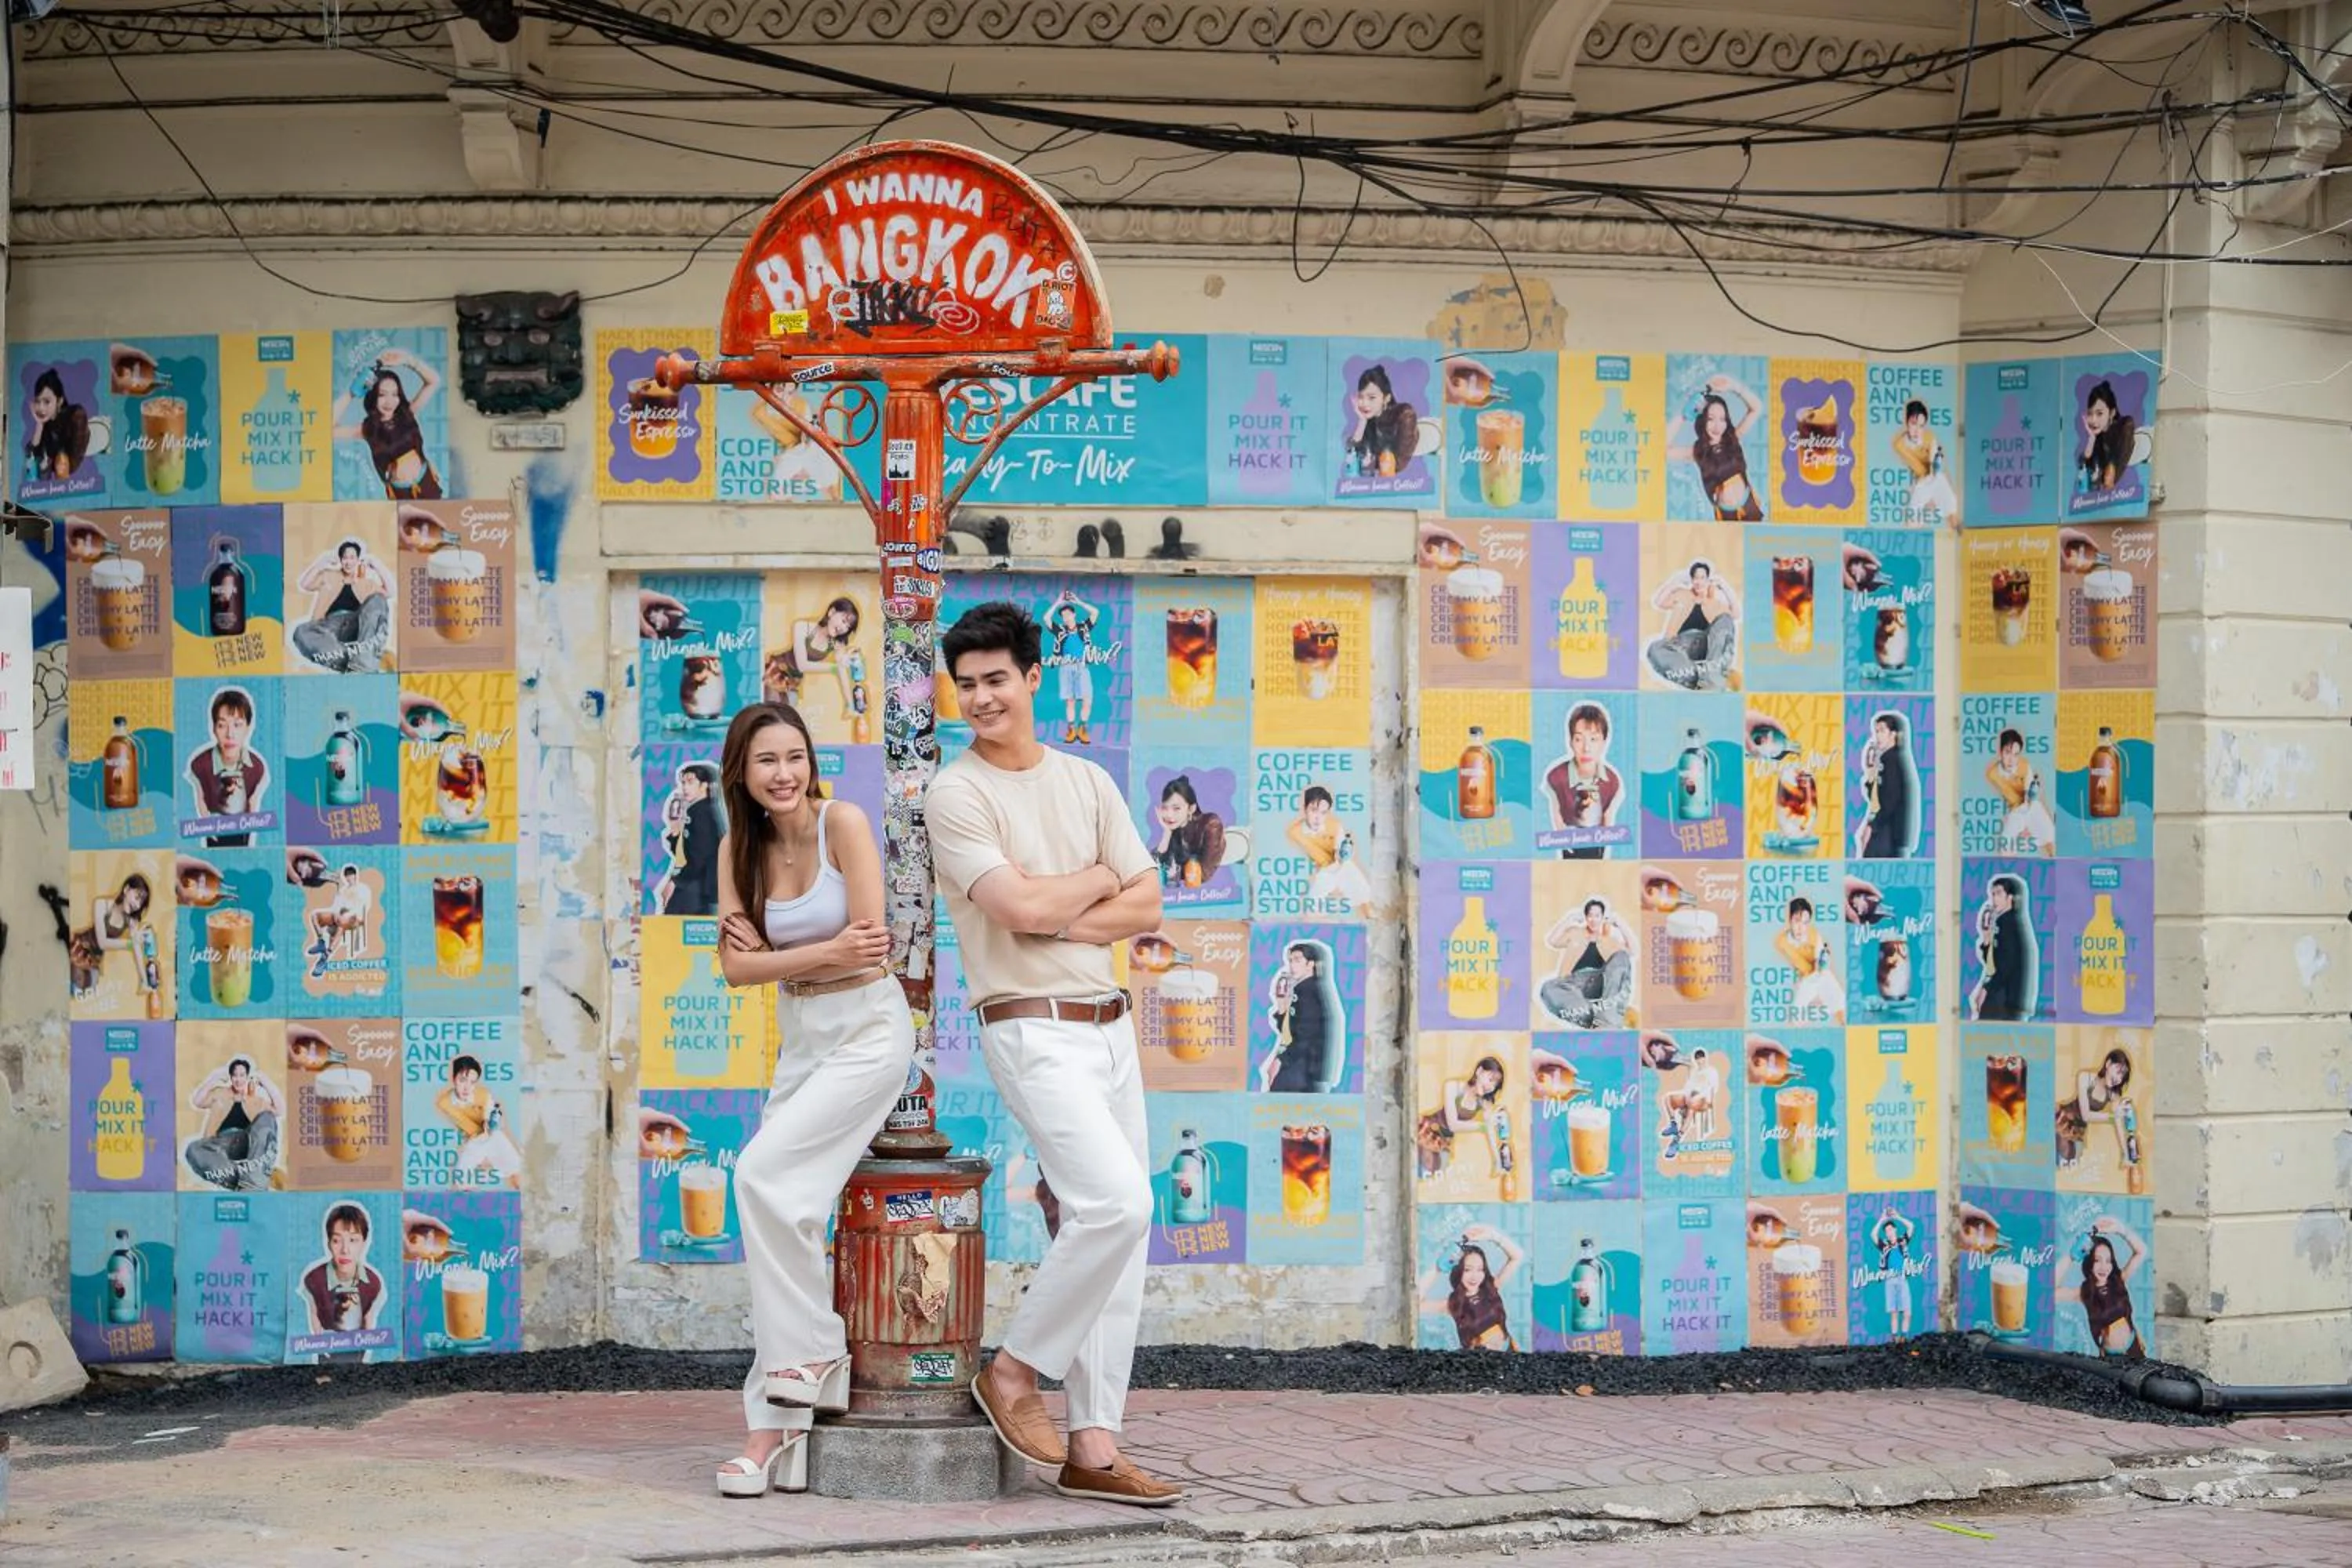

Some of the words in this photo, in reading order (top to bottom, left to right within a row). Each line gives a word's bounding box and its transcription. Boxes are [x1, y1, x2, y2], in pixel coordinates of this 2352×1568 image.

[824, 188, 837, 215] I
[845, 172, 983, 219] WANNA
[756, 215, 1053, 328] BANGKOK
[793, 363, 833, 381] source
[1869, 367, 1944, 386] COFFEE
[1869, 388, 1912, 404] AND
[241, 412, 288, 426] POUR
[299, 412, 317, 424] IT
[619, 402, 688, 423] Sunkissed
[1229, 415, 1283, 429] POUR
[1290, 416, 1308, 430] IT
[248, 431, 280, 445] MIX
[289, 431, 305, 445] IT
[636, 423, 696, 442] Espresso
[1580, 430, 1624, 445] POUR
[1635, 431, 1651, 445] IT
[125, 435, 155, 450] Latte
[162, 432, 212, 450] Matcha
[1235, 435, 1269, 448] MIX
[1279, 436, 1297, 448] IT
[1982, 439, 2024, 453] POUR
[2031, 437, 2045, 451] IT
[241, 451, 291, 465] HACK
[299, 450, 316, 464] IT
[1229, 453, 1281, 468] HACK
[1290, 455, 1307, 468] IT
[1459, 449, 1490, 463] Latte
[1497, 448, 1549, 464] Matcha
[1585, 450, 1616, 463] MIX
[1624, 451, 1641, 463] IT
[1987, 457, 2016, 470] MIX
[2022, 457, 2035, 470] IT
[721, 461, 774, 477] AND
[1579, 469, 1624, 484] HACK
[1634, 470, 1650, 484] IT
[721, 479, 817, 495] STORIES
[1981, 475, 2024, 490] HACK
[2030, 474, 2045, 488] IT
[1870, 489, 1911, 506] AND
[1870, 508, 1942, 524] STORIES
[470, 523, 510, 549] Easy
[2120, 543, 2154, 568] Easy
[1900, 583, 1933, 606] Mix?
[1550, 600, 1598, 614] POUR
[1606, 600, 1623, 614] IT
[1556, 618, 1587, 632] MIX
[1595, 619, 1611, 632] IT
[713, 628, 755, 655] Mix?
[1083, 642, 1122, 666] Mix?
[406, 674, 464, 701] MIX
[480, 676, 514, 701] IT
[1962, 698, 2041, 714] COFFEE
[1962, 717, 2007, 734] AND
[473, 728, 514, 752] Mix?
[1257, 753, 1352, 771] COFFEE
[1258, 773, 1312, 790] AND
[1962, 818, 2003, 834] AND
[1962, 837, 2038, 852] STORIES
[1749, 866, 1829, 882] COFFEE
[1258, 879, 1309, 895] AND
[1750, 887, 1795, 902] AND
[1258, 898, 1351, 914] STORIES
[190, 947, 223, 963] Latte
[227, 944, 278, 963] Matcha
[1439, 941, 1489, 954] POUR
[1497, 942, 1513, 954] IT
[1203, 943, 1245, 970] Easy
[1446, 959, 1477, 972] MIX
[1486, 959, 1502, 972] IT
[664, 996, 717, 1010] POUR
[728, 996, 745, 1010] IT
[1751, 989, 1795, 1005] AND
[670, 1015, 706, 1029] MIX
[714, 1015, 731, 1029] IT
[1751, 1006, 1829, 1022] STORIES
[406, 1023, 502, 1040] COFFEE
[664, 1035, 718, 1049] HACK
[726, 1036, 744, 1049] IT
[1142, 1038, 1193, 1047] CREAMY
[1198, 1038, 1236, 1047] LATTE
[357, 1041, 397, 1067] Easy
[406, 1044, 461, 1061] AND
[1600, 1083, 1639, 1109] Mix?
[88, 1101, 135, 1114] POUR
[143, 1101, 158, 1114] IT
[1865, 1102, 1907, 1116] POUR
[1914, 1102, 1926, 1115] IT
[94, 1120, 125, 1134] MIX
[132, 1120, 147, 1134] IT
[1760, 1127, 1789, 1142] Latte
[1795, 1124, 1839, 1140] Matcha
[1871, 1121, 1899, 1134] MIX
[1905, 1121, 1917, 1134] IT
[1866, 1139, 1906, 1153] HACK
[1913, 1139, 1926, 1153] IT
[406, 1151, 459, 1167] AND
[406, 1169, 500, 1185] STORIES
[477, 1246, 520, 1272] Mix?
[2020, 1245, 2054, 1269] Mix?
[1901, 1254, 1932, 1278] Mix?
[195, 1272, 241, 1287] POUR
[252, 1272, 269, 1287] IT
[1662, 1279, 1705, 1293] POUR
[1715, 1276, 1731, 1291] IT
[201, 1293, 233, 1306] MIX
[241, 1292, 258, 1306] IT
[1668, 1298, 1698, 1312] MIX
[1705, 1297, 1721, 1311] IT
[195, 1312, 243, 1327] HACK
[252, 1312, 267, 1327] IT
[1662, 1316, 1707, 1331] HACK
[1715, 1315, 1731, 1329] IT
